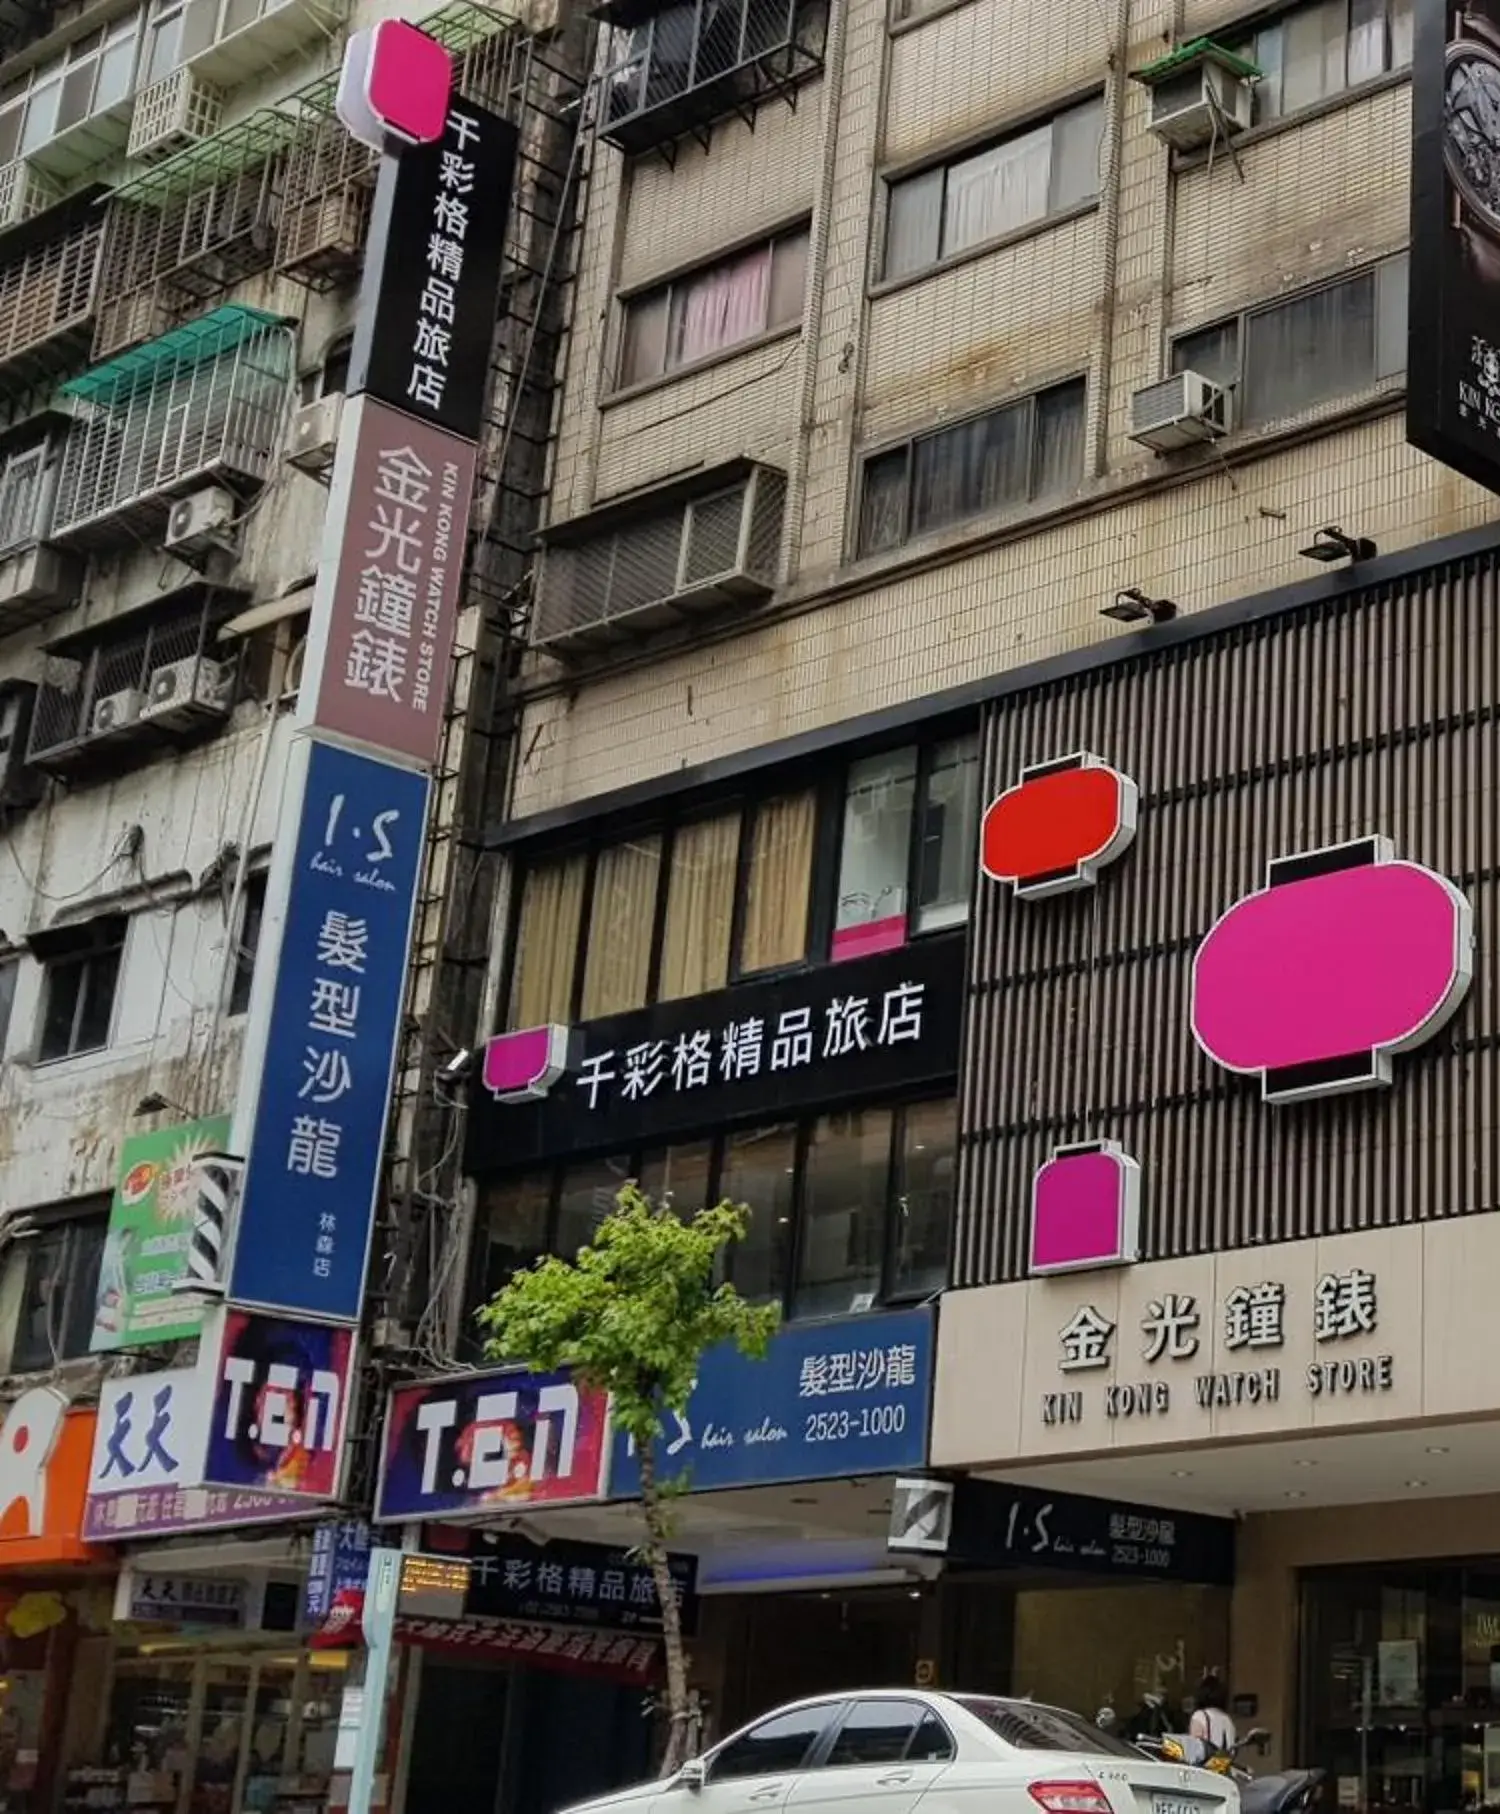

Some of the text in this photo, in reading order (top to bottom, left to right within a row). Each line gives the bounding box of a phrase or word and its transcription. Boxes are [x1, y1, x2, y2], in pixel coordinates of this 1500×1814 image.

[407, 109, 481, 411] 千彩格精品旅店
[344, 445, 433, 704] 金光鐘錶
[411, 461, 459, 714] KIN KONG WATCH STORE
[310, 853, 397, 892] hair salon
[287, 909, 369, 1180] 髮型沙龍
[576, 981, 927, 1110] 千彩格精品旅店
[799, 1343, 917, 1399] 髮型沙龍
[1058, 1268, 1377, 1374] 金光鐘錶
[804, 1404, 906, 1444] 2523-1000
[1041, 1354, 1394, 1426] KIN KONG WATCH STORE
